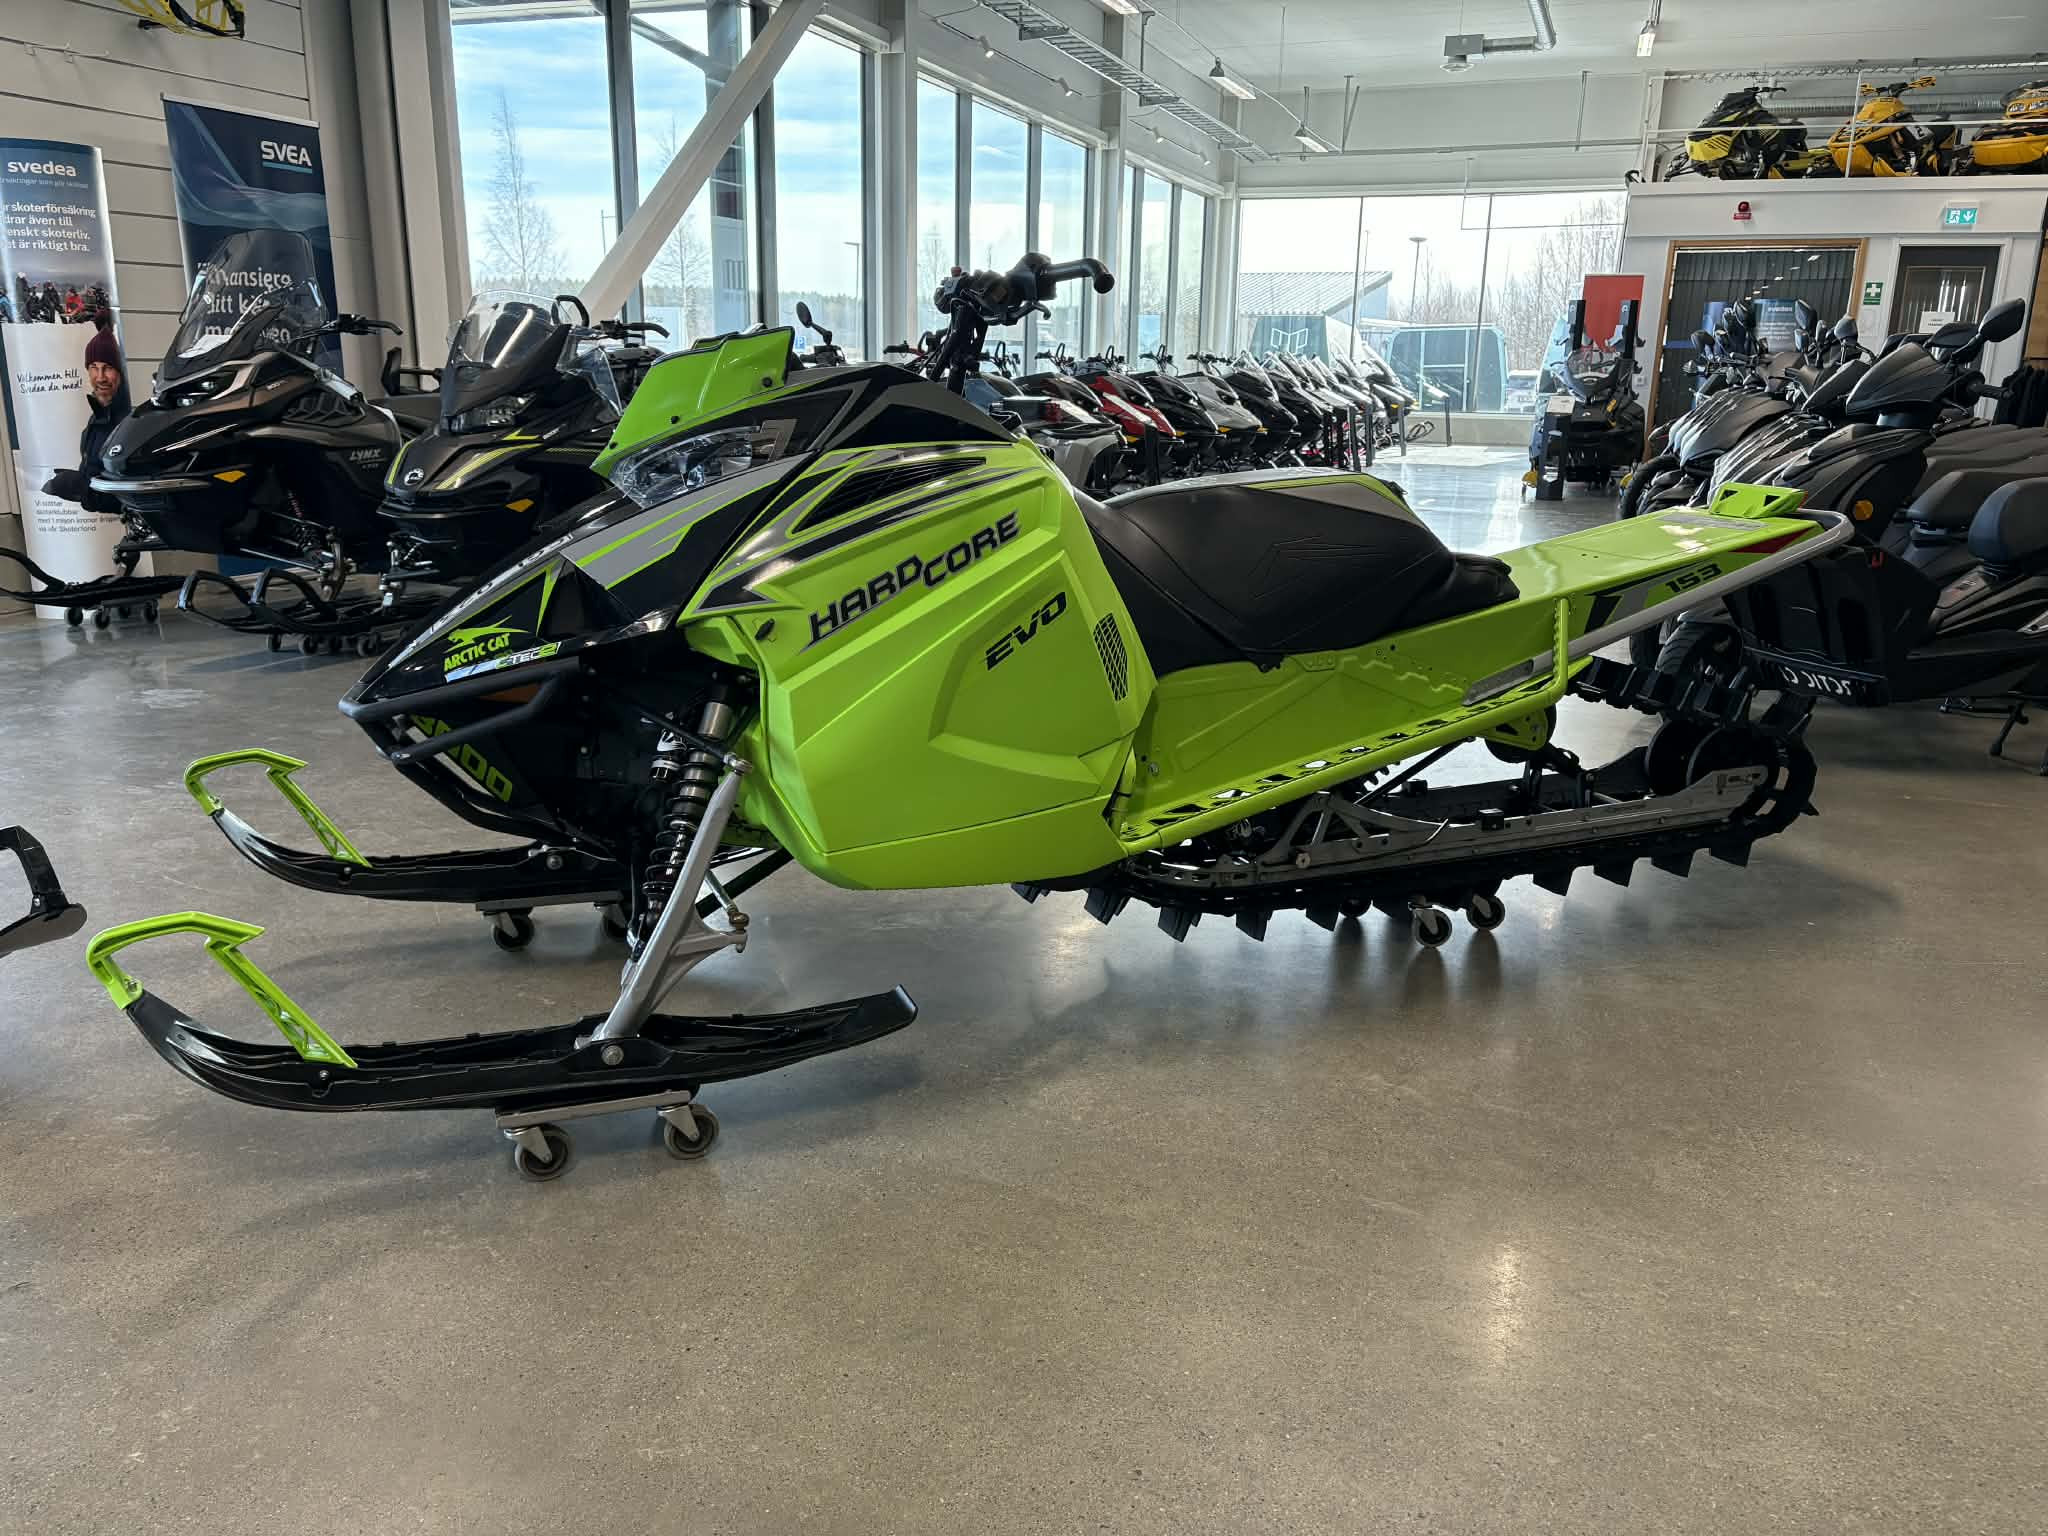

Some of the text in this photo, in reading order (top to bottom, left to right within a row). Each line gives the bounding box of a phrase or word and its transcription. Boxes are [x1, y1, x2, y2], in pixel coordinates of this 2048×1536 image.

[261, 140, 312, 167] SVEA
[7, 160, 77, 177] svedea
[13, 201, 96, 218] skoterförsäkring
[28, 213, 56, 225] även
[59, 215, 72, 226] till
[7, 226, 91, 240] enskt skoterliv.
[18, 239, 30, 250] är
[32, 240, 69, 252] riktigt
[70, 240, 90, 252] bra.
[349, 448, 381, 461] LYNX
[802, 509, 1021, 648] HARDCORE
[1665, 563, 1722, 593] 153
[984, 591, 1068, 671] EVO
[443, 633, 511, 672] ARCTIC CAT
